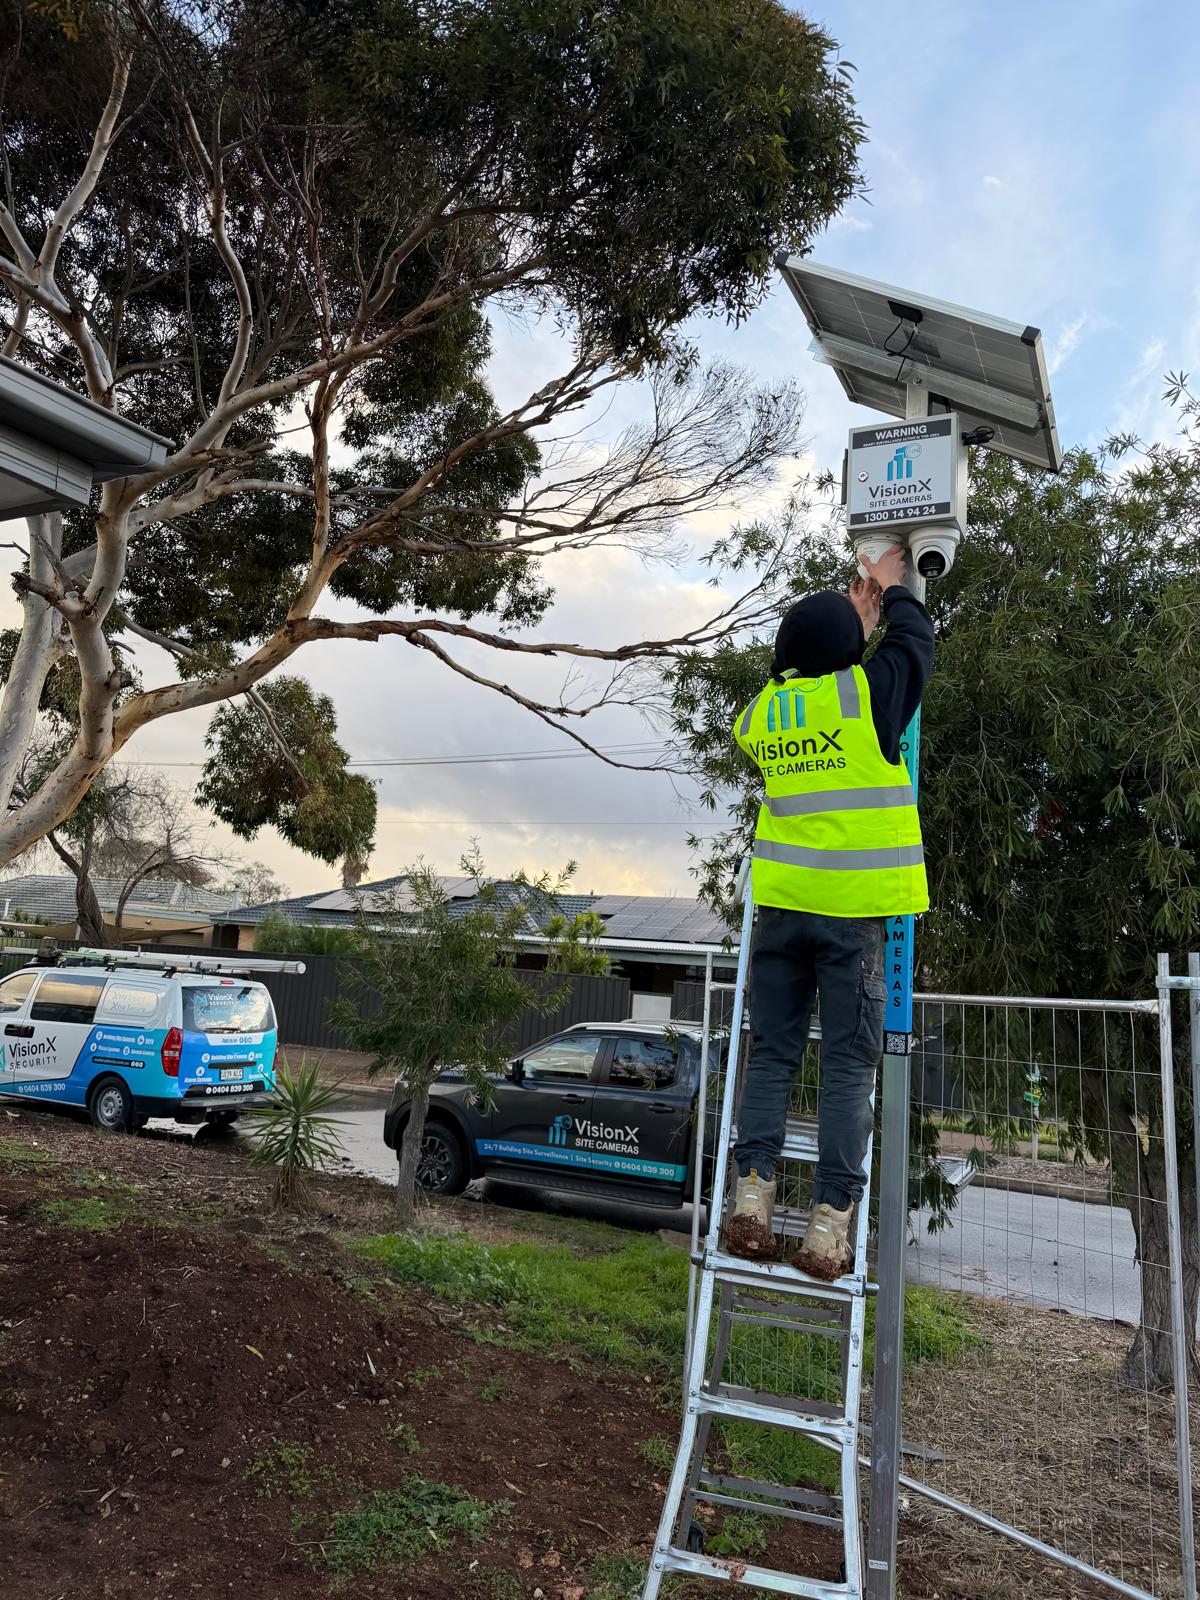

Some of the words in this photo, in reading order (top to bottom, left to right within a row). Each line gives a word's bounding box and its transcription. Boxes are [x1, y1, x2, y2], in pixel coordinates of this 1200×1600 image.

[876, 425, 927, 440] WARNING
[868, 478, 932, 498] VisionX
[869, 500, 887, 508] SITE
[890, 494, 932, 506] CAMERAS
[864, 512, 889, 522] 1300
[892, 510, 904, 519] 14
[907, 508, 920, 516] 94
[923, 506, 936, 515] 24
[749, 728, 844, 762] VisionX
[762, 766, 774, 778] TE
[776, 757, 846, 776] CAMERAS
[892, 915, 904, 1008] AMERAS
[9, 1036, 56, 1058] VisionX
[10, 1056, 57, 1070] SECURITY
[575, 1118, 640, 1143] VisionX
[575, 1138, 594, 1149] SITE
[596, 1140, 640, 1155] CAMERAS
[484, 1143, 498, 1152] 24/7
[499, 1144, 522, 1156] Building
[522, 1147, 533, 1156] Site
[533, 1148, 568, 1160] Surveillance
[575, 1154, 587, 1163] Site
[588, 1157, 612, 1168] Security
[621, 1162, 641, 1172] 0404
[642, 1164, 658, 1174] 839
[659, 1166, 675, 1177] 300
